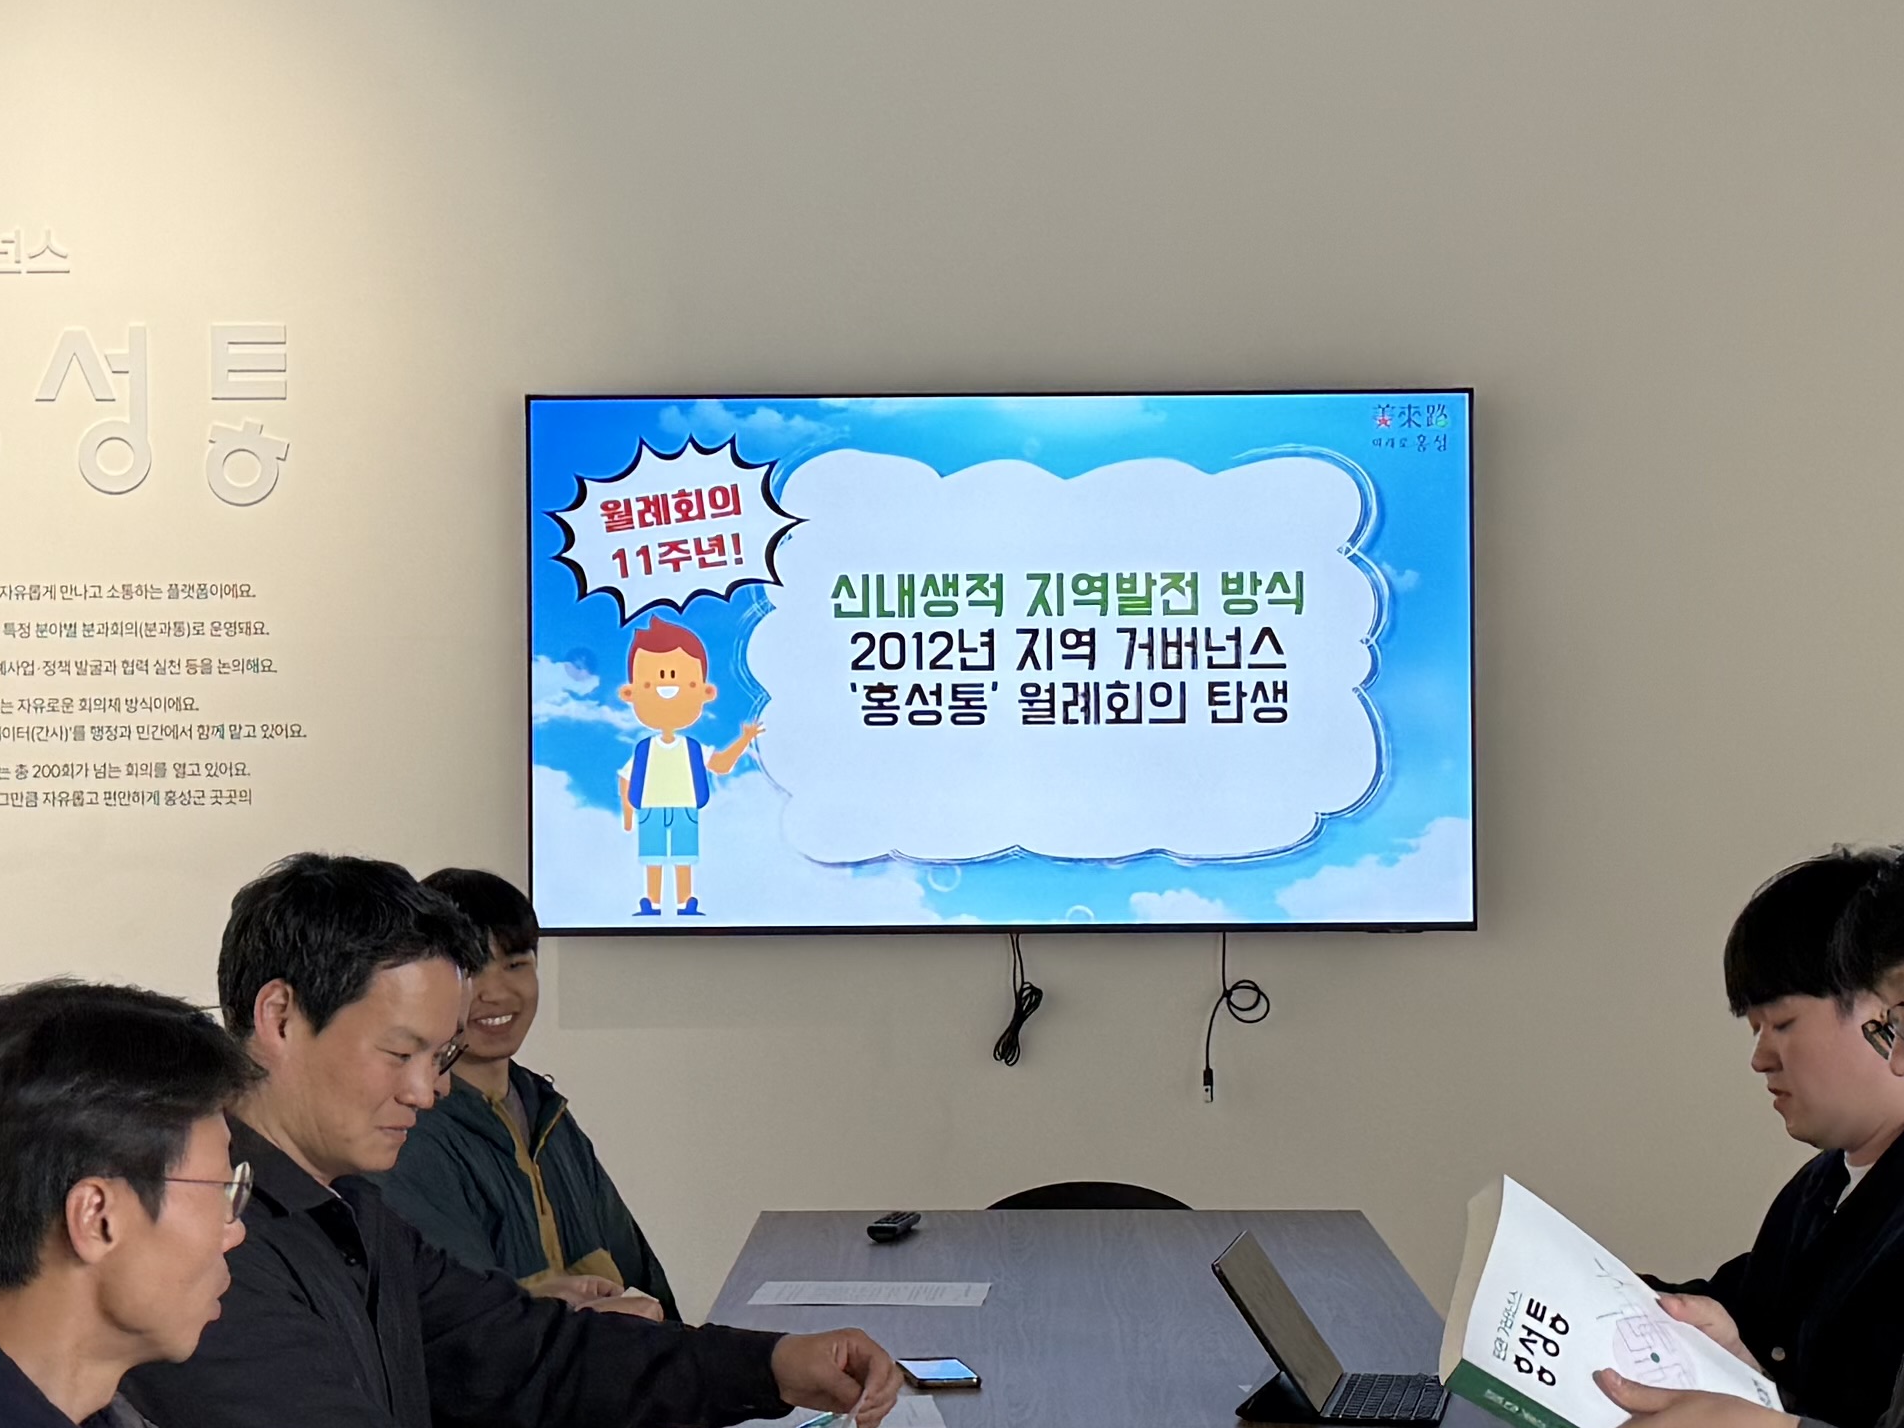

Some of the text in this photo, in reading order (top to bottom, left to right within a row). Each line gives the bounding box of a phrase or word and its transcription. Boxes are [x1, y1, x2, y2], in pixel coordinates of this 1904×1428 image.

[600, 484, 743, 534] 월례회의
[612, 532, 744, 578] 11주년!
[0, 585, 56, 601] 자유롭게
[60, 584, 103, 600] 만나고
[107, 584, 162, 600] 소통하는
[830, 572, 1305, 620] 신내생적 지역발전 방식
[3, 622, 31, 640] 특정
[36, 622, 77, 640] 분야별
[850, 628, 1287, 673] 2012년 지역 거버넌스
[75, 659, 116, 676] 발굴과
[153, 659, 181, 676] 실천
[186, 659, 213, 676] 등을
[17, 697, 74, 714] 자유로운
[79, 696, 121, 714] 회의체
[1018, 680, 1188, 726] 월례회의
[1208, 680, 1289, 724] 탄생
[90, 724, 131, 741] 행정과
[136, 724, 192, 741] 민간에서
[197, 724, 224, 741] 함께
[32, 763, 89, 780] 200회가
[94, 763, 121, 780] 넘는
[126, 762, 167, 779] 회의를
[43, 790, 99, 808] 자유롭고
[164, 789, 205, 807] 홍성군
[210, 788, 251, 806] 곳곳의
[1513, 1297, 1570, 1386] 홍성통
